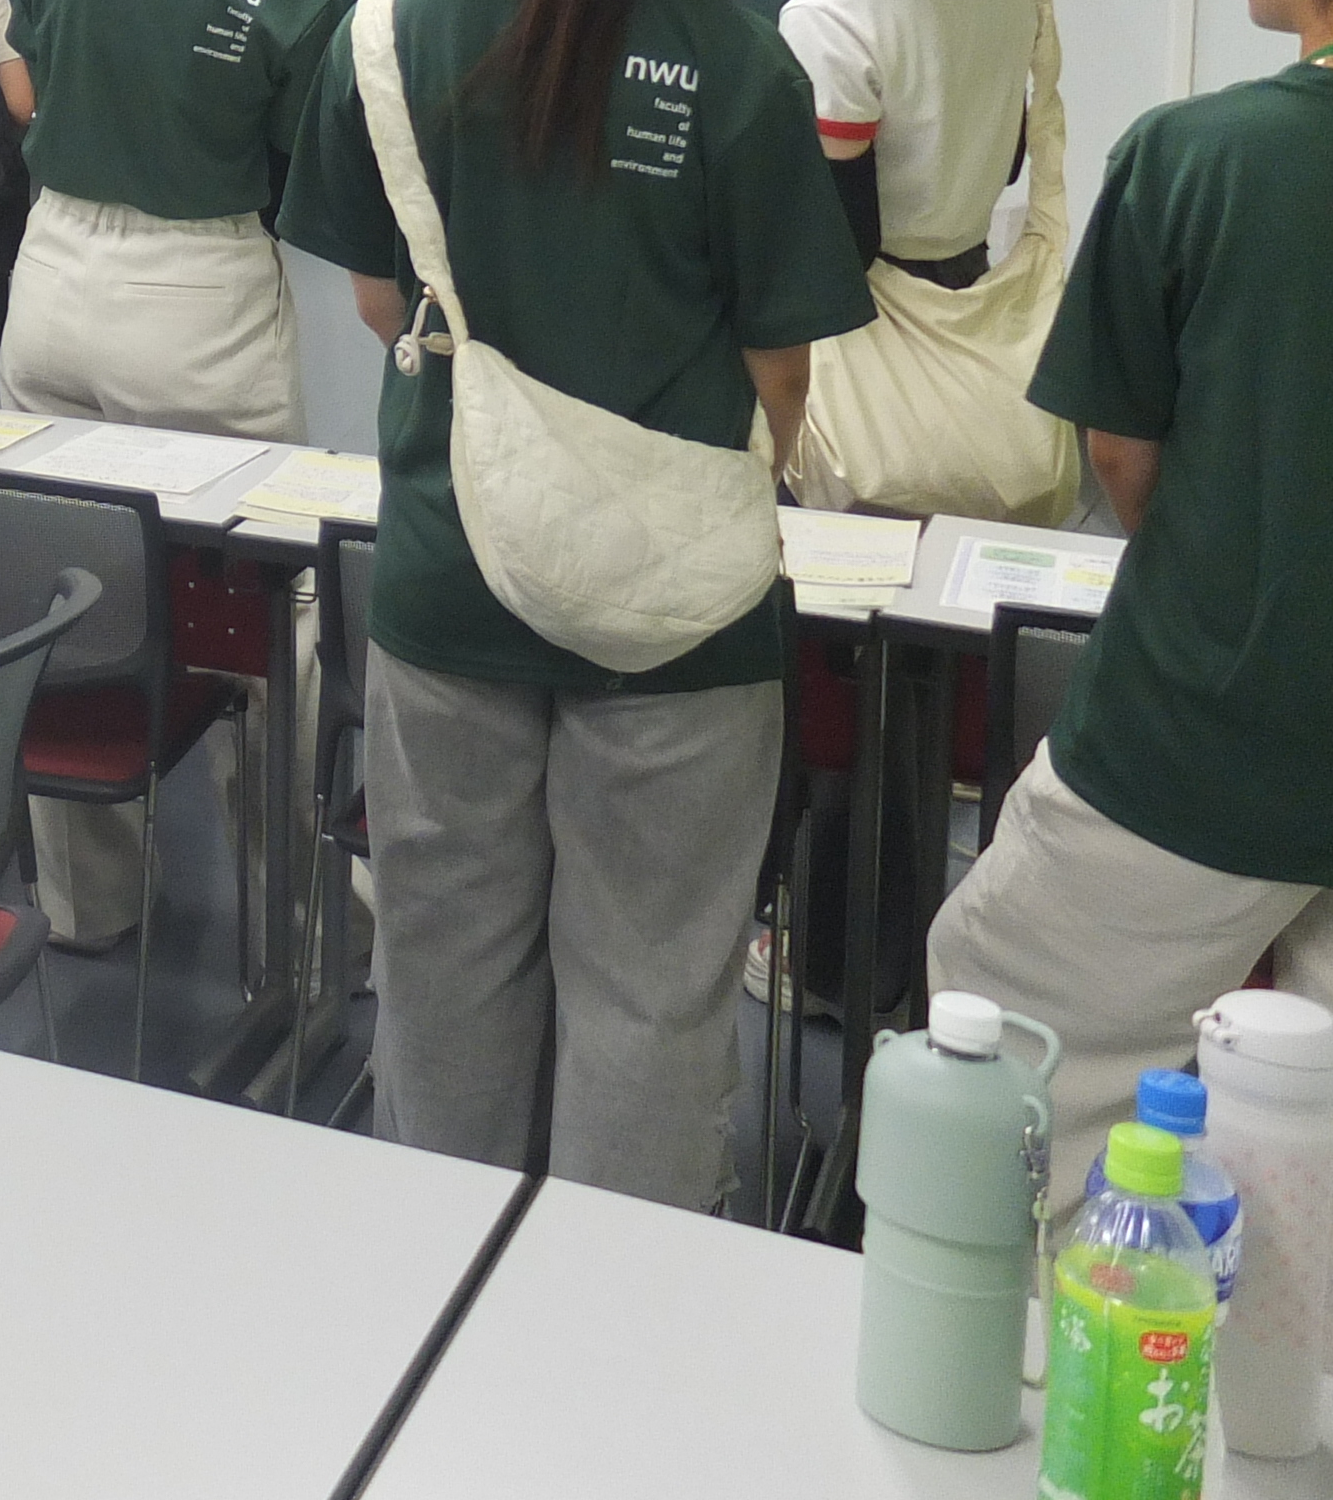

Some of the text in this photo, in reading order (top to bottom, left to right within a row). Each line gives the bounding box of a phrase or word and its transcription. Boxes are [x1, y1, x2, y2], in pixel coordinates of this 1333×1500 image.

[624, 55, 699, 92] nwu
[653, 97, 693, 118] faculty
[677, 120, 691, 132] of
[626, 125, 688, 149] human life
[610, 158, 679, 179] environment
[662, 151, 685, 165] and
